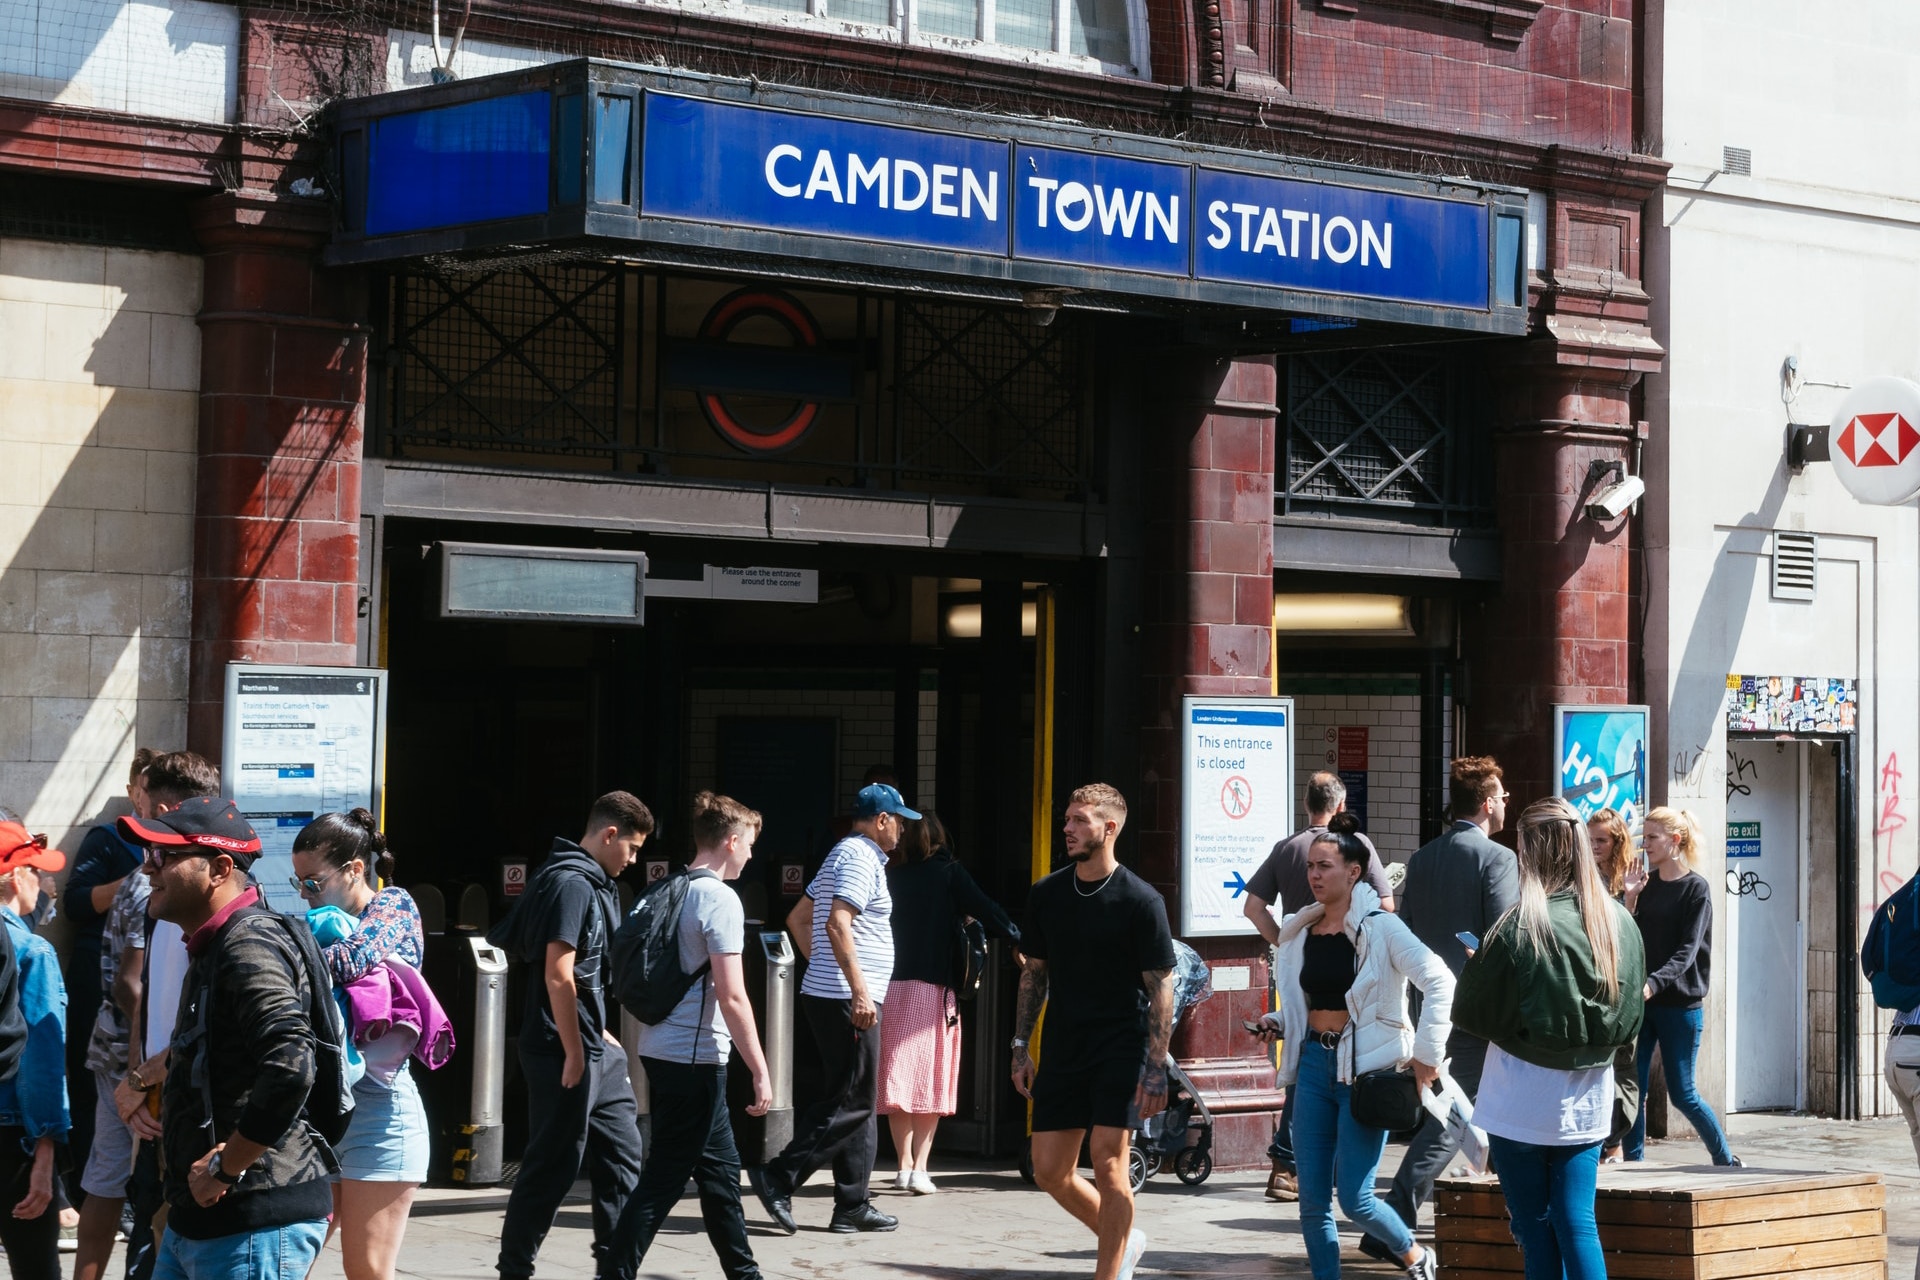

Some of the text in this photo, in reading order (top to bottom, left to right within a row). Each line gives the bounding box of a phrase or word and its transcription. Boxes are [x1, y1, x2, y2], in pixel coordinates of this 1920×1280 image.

[765, 144, 1393, 269] CAMDEN TOWN STATION
[722, 567, 744, 575] Please
[759, 569, 770, 577] the
[772, 570, 801, 578] entrance
[766, 578, 777, 586] the
[779, 579, 801, 587] corner
[242, 684, 279, 692] Northern line
[243, 702, 329, 710] Trains from Camden Town
[1197, 735, 1272, 750] This entrance
[1197, 756, 1245, 769] is closed
[1727, 824, 1759, 837] ire exit
[1195, 833, 1215, 842] Please
[1239, 835, 1265, 843] entrance
[1727, 843, 1760, 856] eep clear
[1195, 856, 1217, 864] Kentish
[1219, 856, 1235, 864] Town
